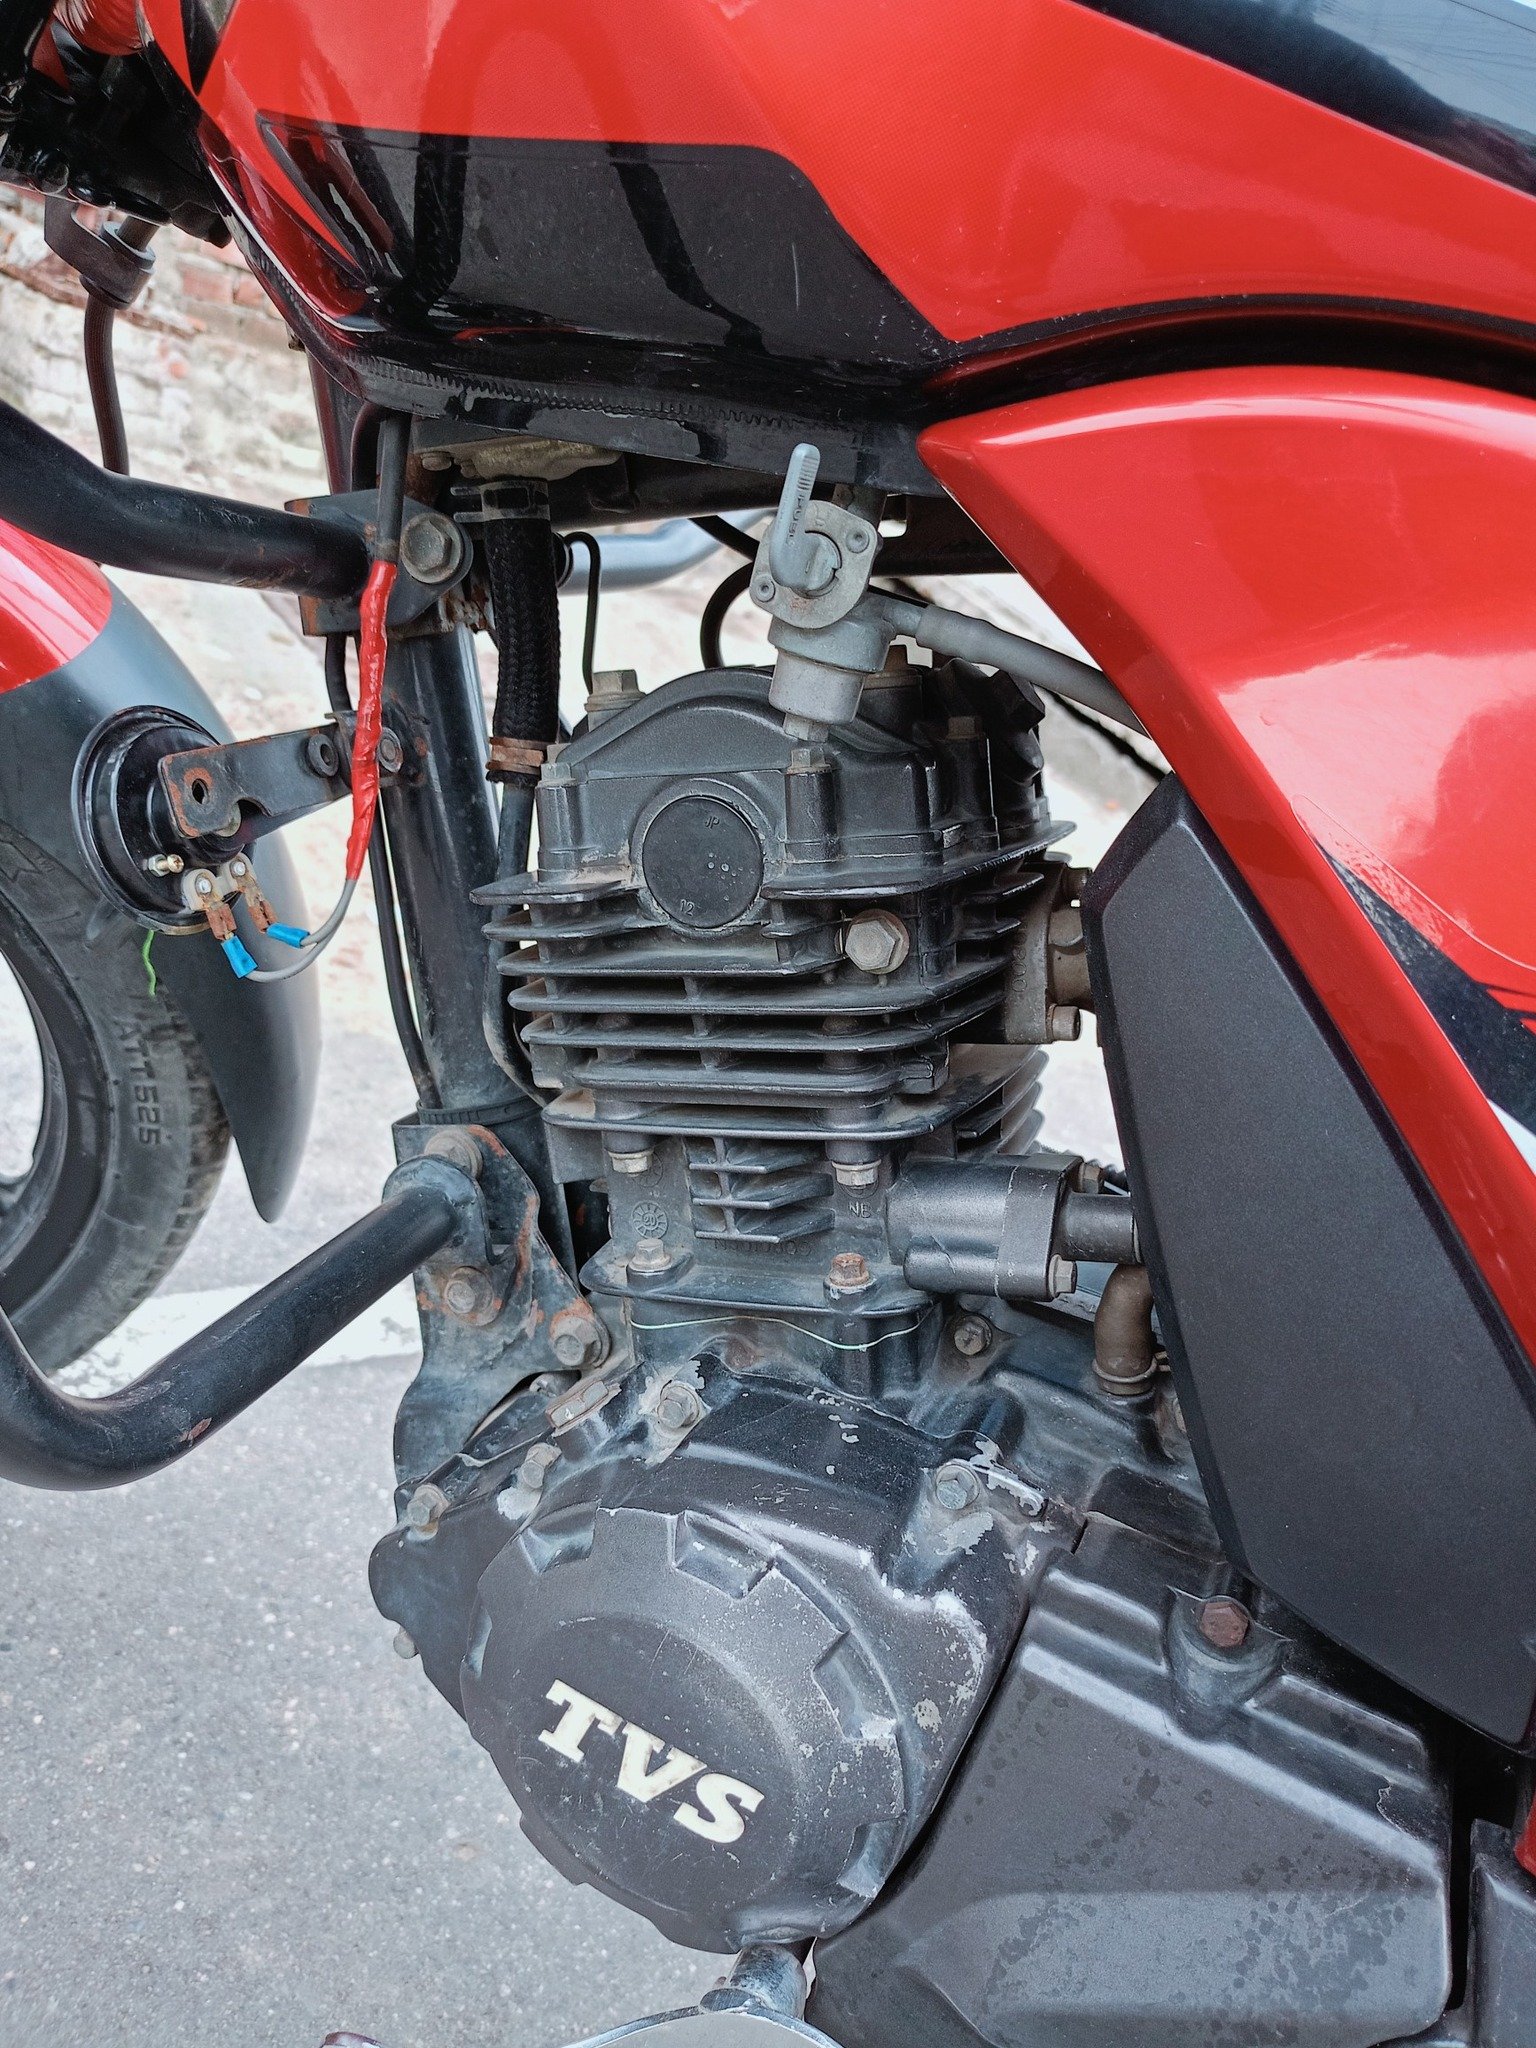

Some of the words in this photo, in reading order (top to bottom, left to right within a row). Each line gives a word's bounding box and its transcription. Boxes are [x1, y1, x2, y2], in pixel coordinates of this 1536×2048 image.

[705, 816, 720, 829] JP
[680, 899, 695, 917] 12
[538, 1679, 765, 1843] TVS
